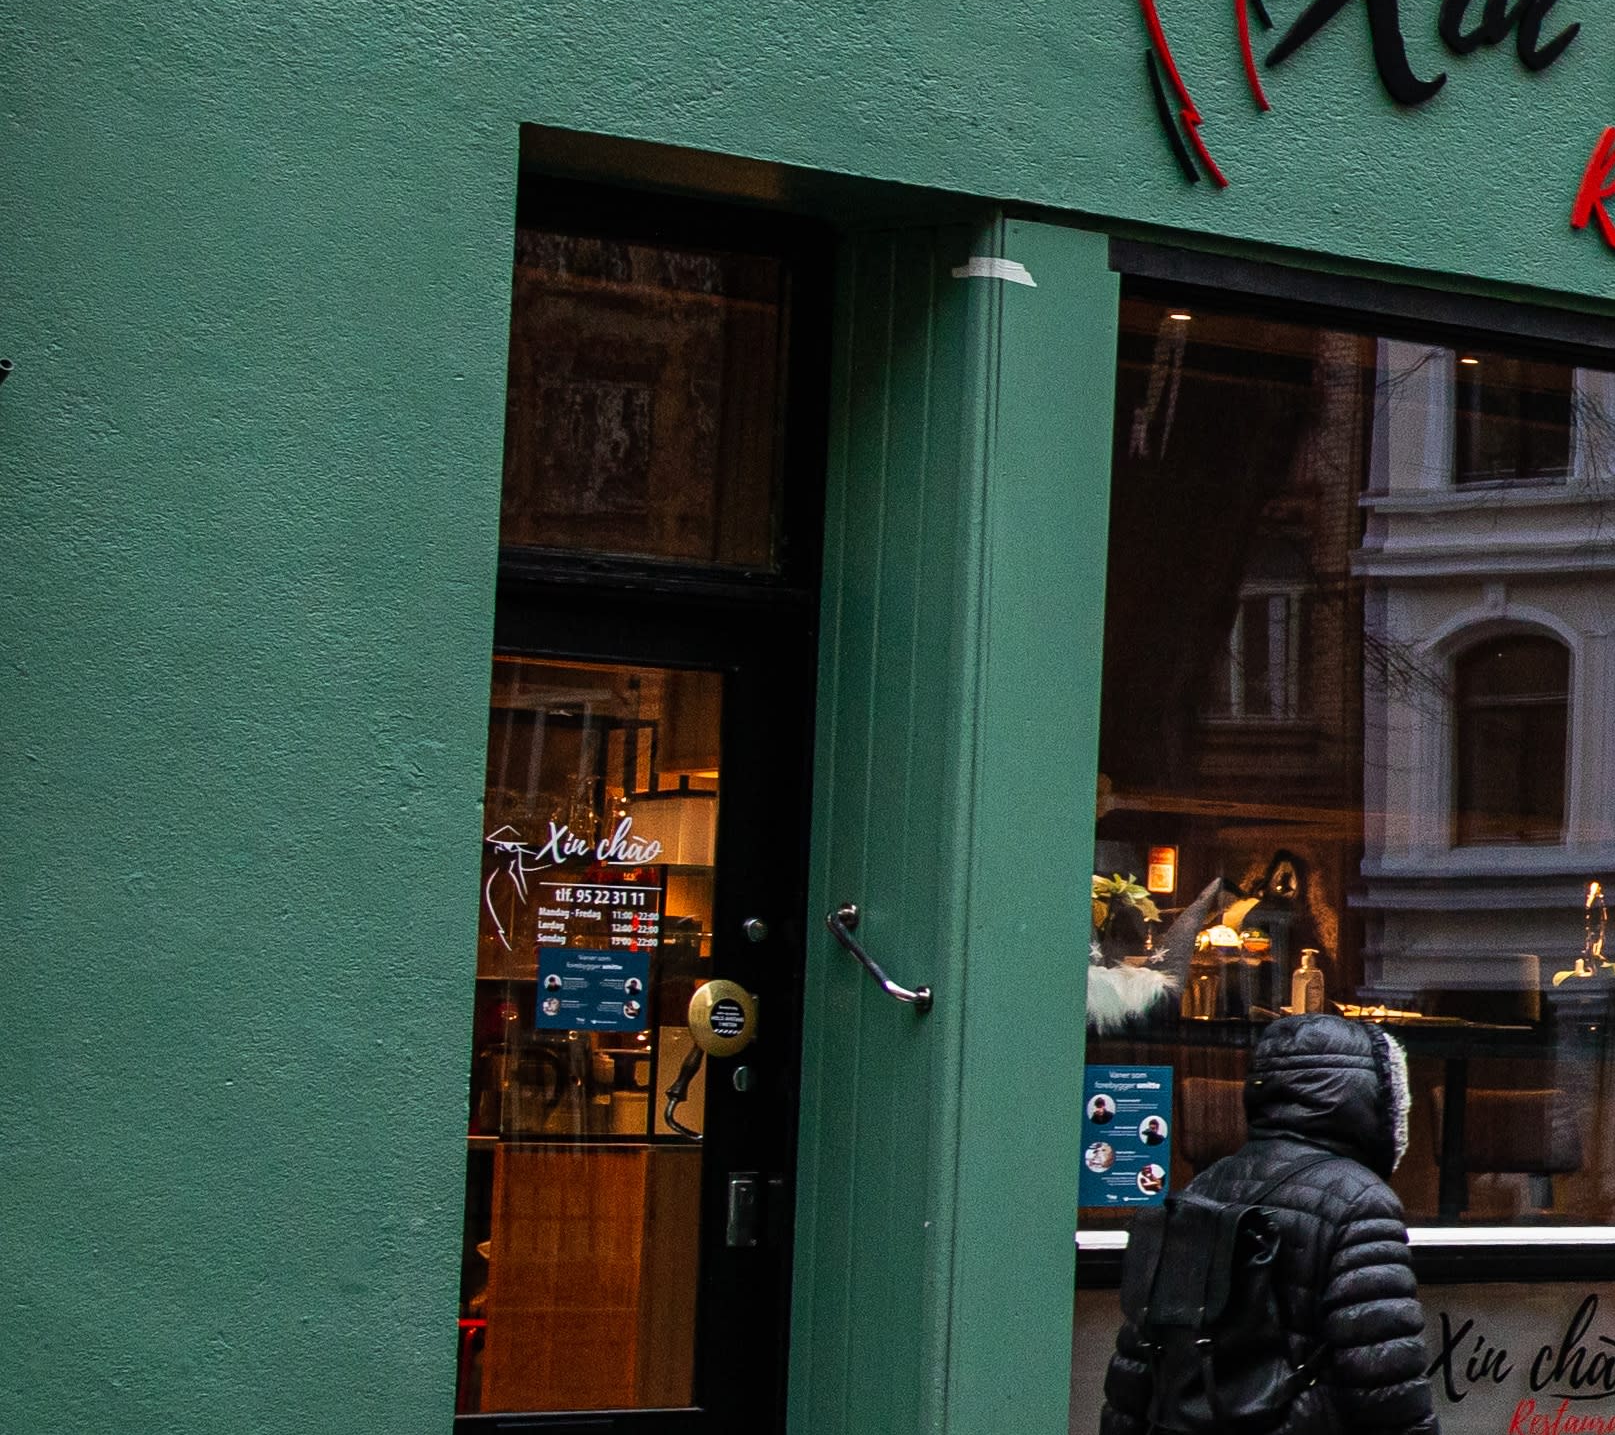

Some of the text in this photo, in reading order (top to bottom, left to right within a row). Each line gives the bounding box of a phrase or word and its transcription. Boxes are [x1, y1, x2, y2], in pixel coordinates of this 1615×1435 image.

[536, 821, 590, 864] Xin
[556, 889, 645, 905] tlf. 95 22 31 11
[538, 907, 570, 920] Mandag
[575, 908, 602, 920] Fredag
[1427, 1311, 1513, 1404] Xin
